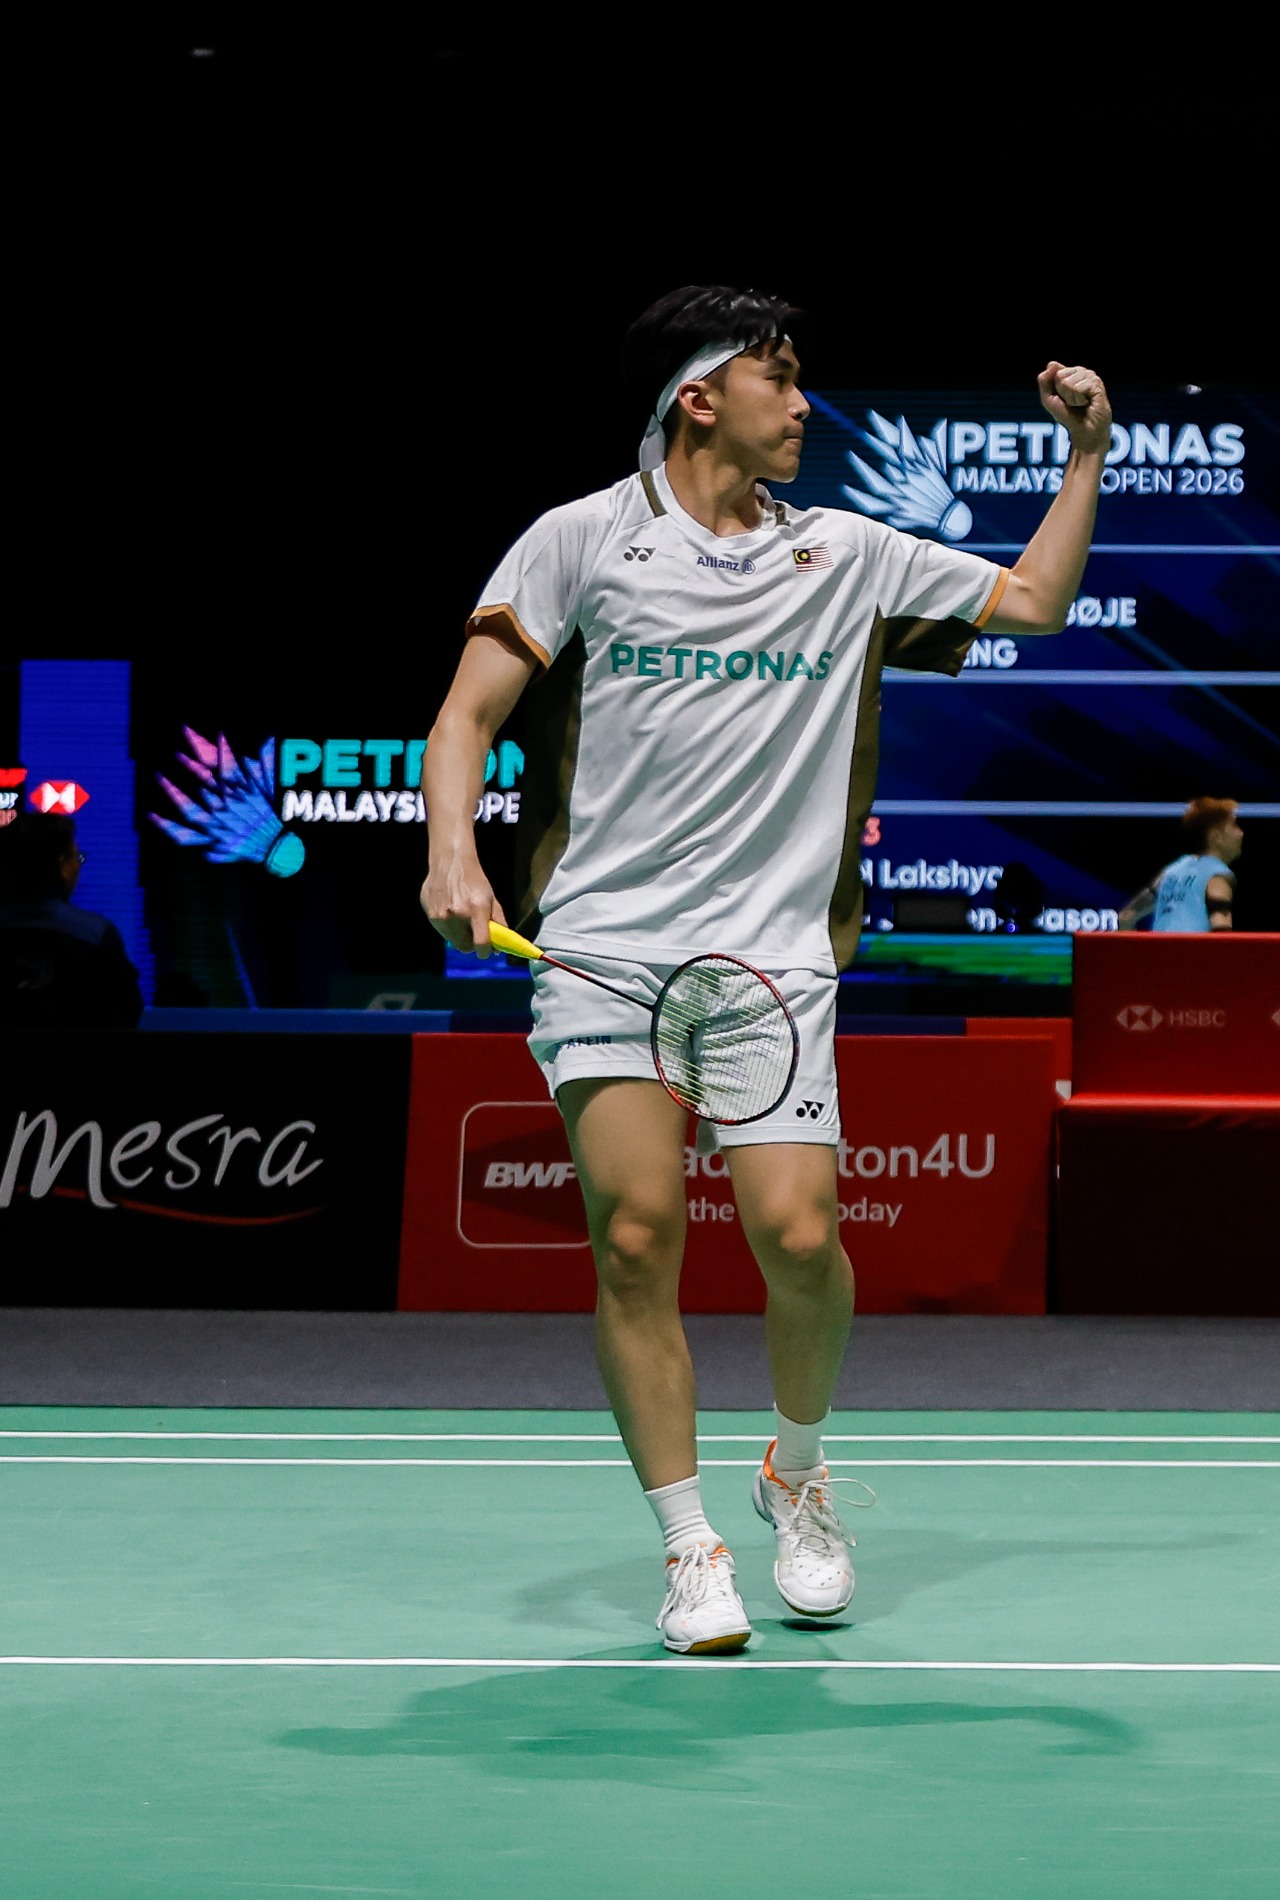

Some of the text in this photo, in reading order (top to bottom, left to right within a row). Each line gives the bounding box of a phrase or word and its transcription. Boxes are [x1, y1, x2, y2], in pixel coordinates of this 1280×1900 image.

[953, 466, 1245, 494] MALAYS OPEN 2026
[696, 555, 740, 572] Allianz
[610, 643, 834, 681] PETRONAS
[281, 790, 428, 824] MALAYSI
[1169, 1009, 1227, 1027] HSBC
[484, 1162, 577, 1188] BWF
[689, 1196, 903, 1228] the oday
